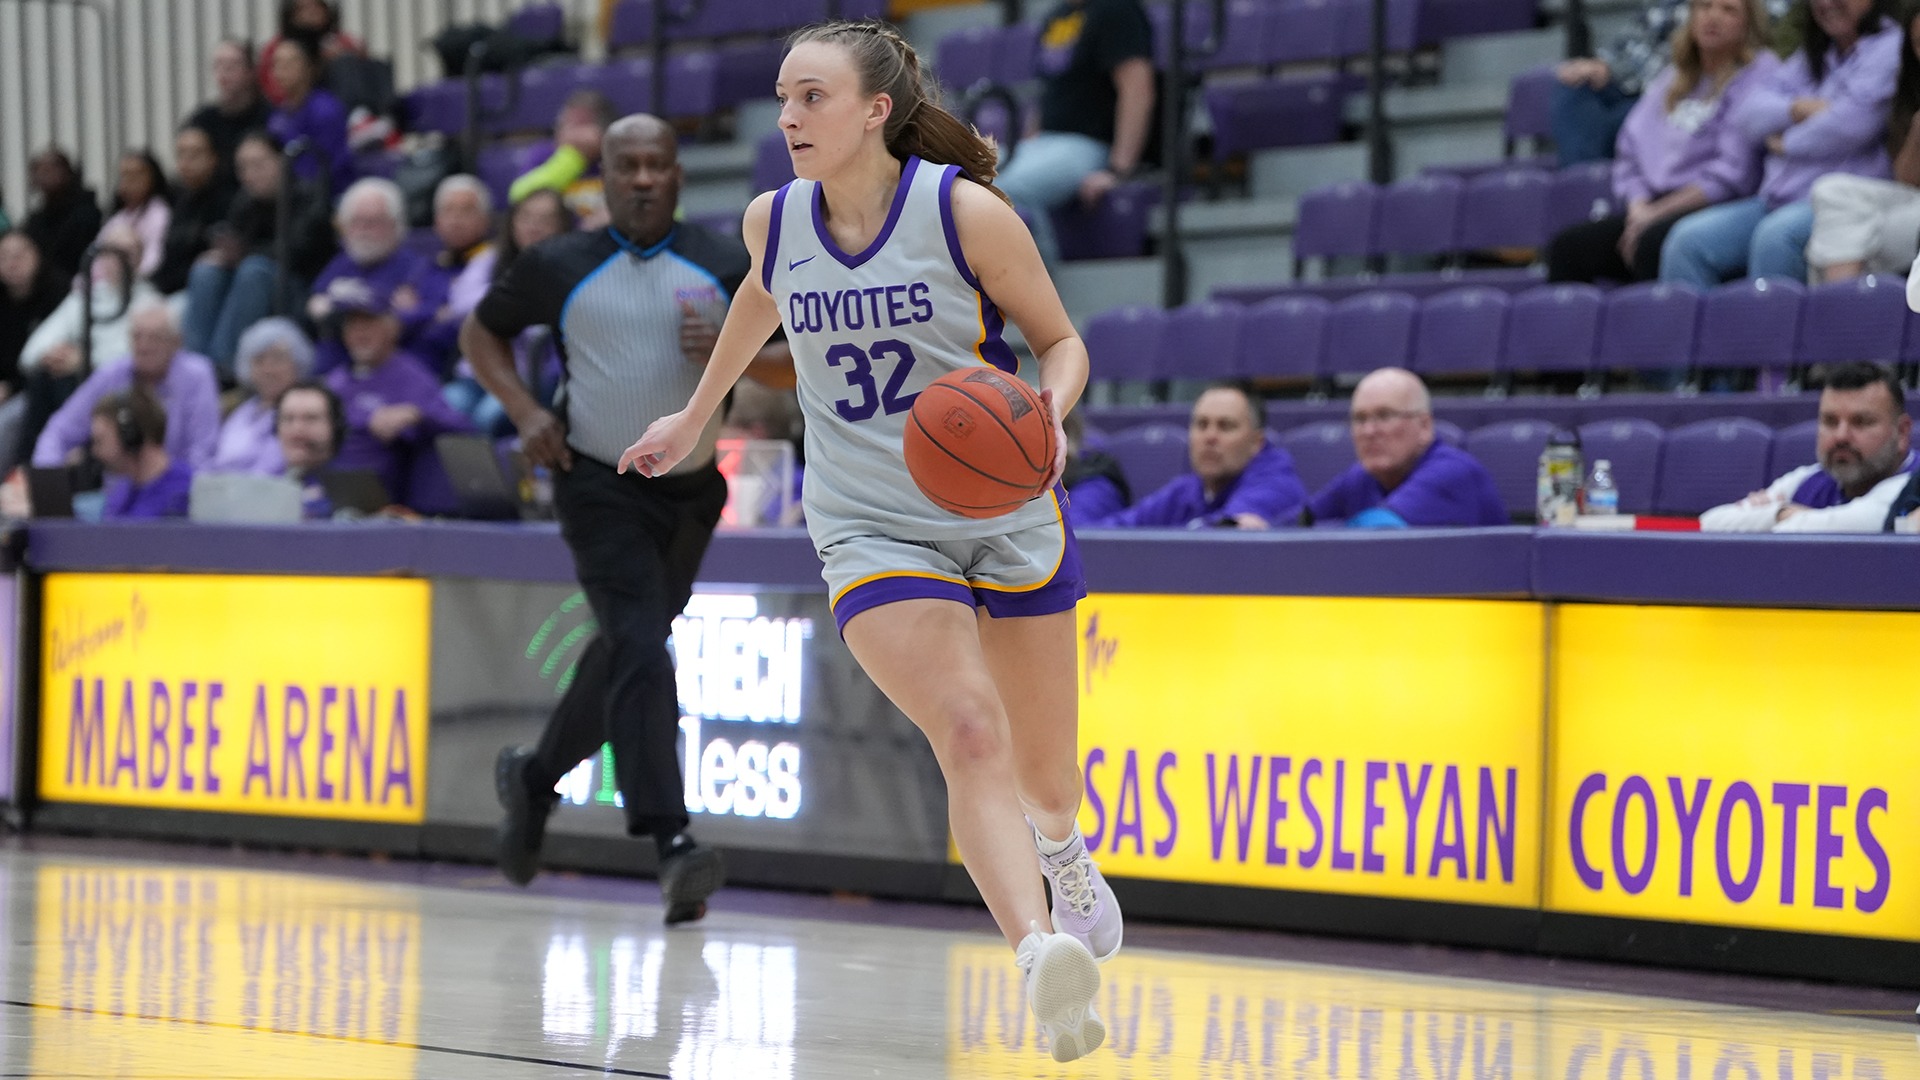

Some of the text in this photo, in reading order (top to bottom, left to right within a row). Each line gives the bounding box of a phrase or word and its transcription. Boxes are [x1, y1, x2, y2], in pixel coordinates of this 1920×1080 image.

[789, 281, 933, 334] COYOTES
[825, 339, 923, 422] 32
[66, 677, 413, 806] MABEE ARENA
[1084, 748, 1518, 884] SAS WESLEYAN
[1568, 771, 1892, 914] COYOTES
